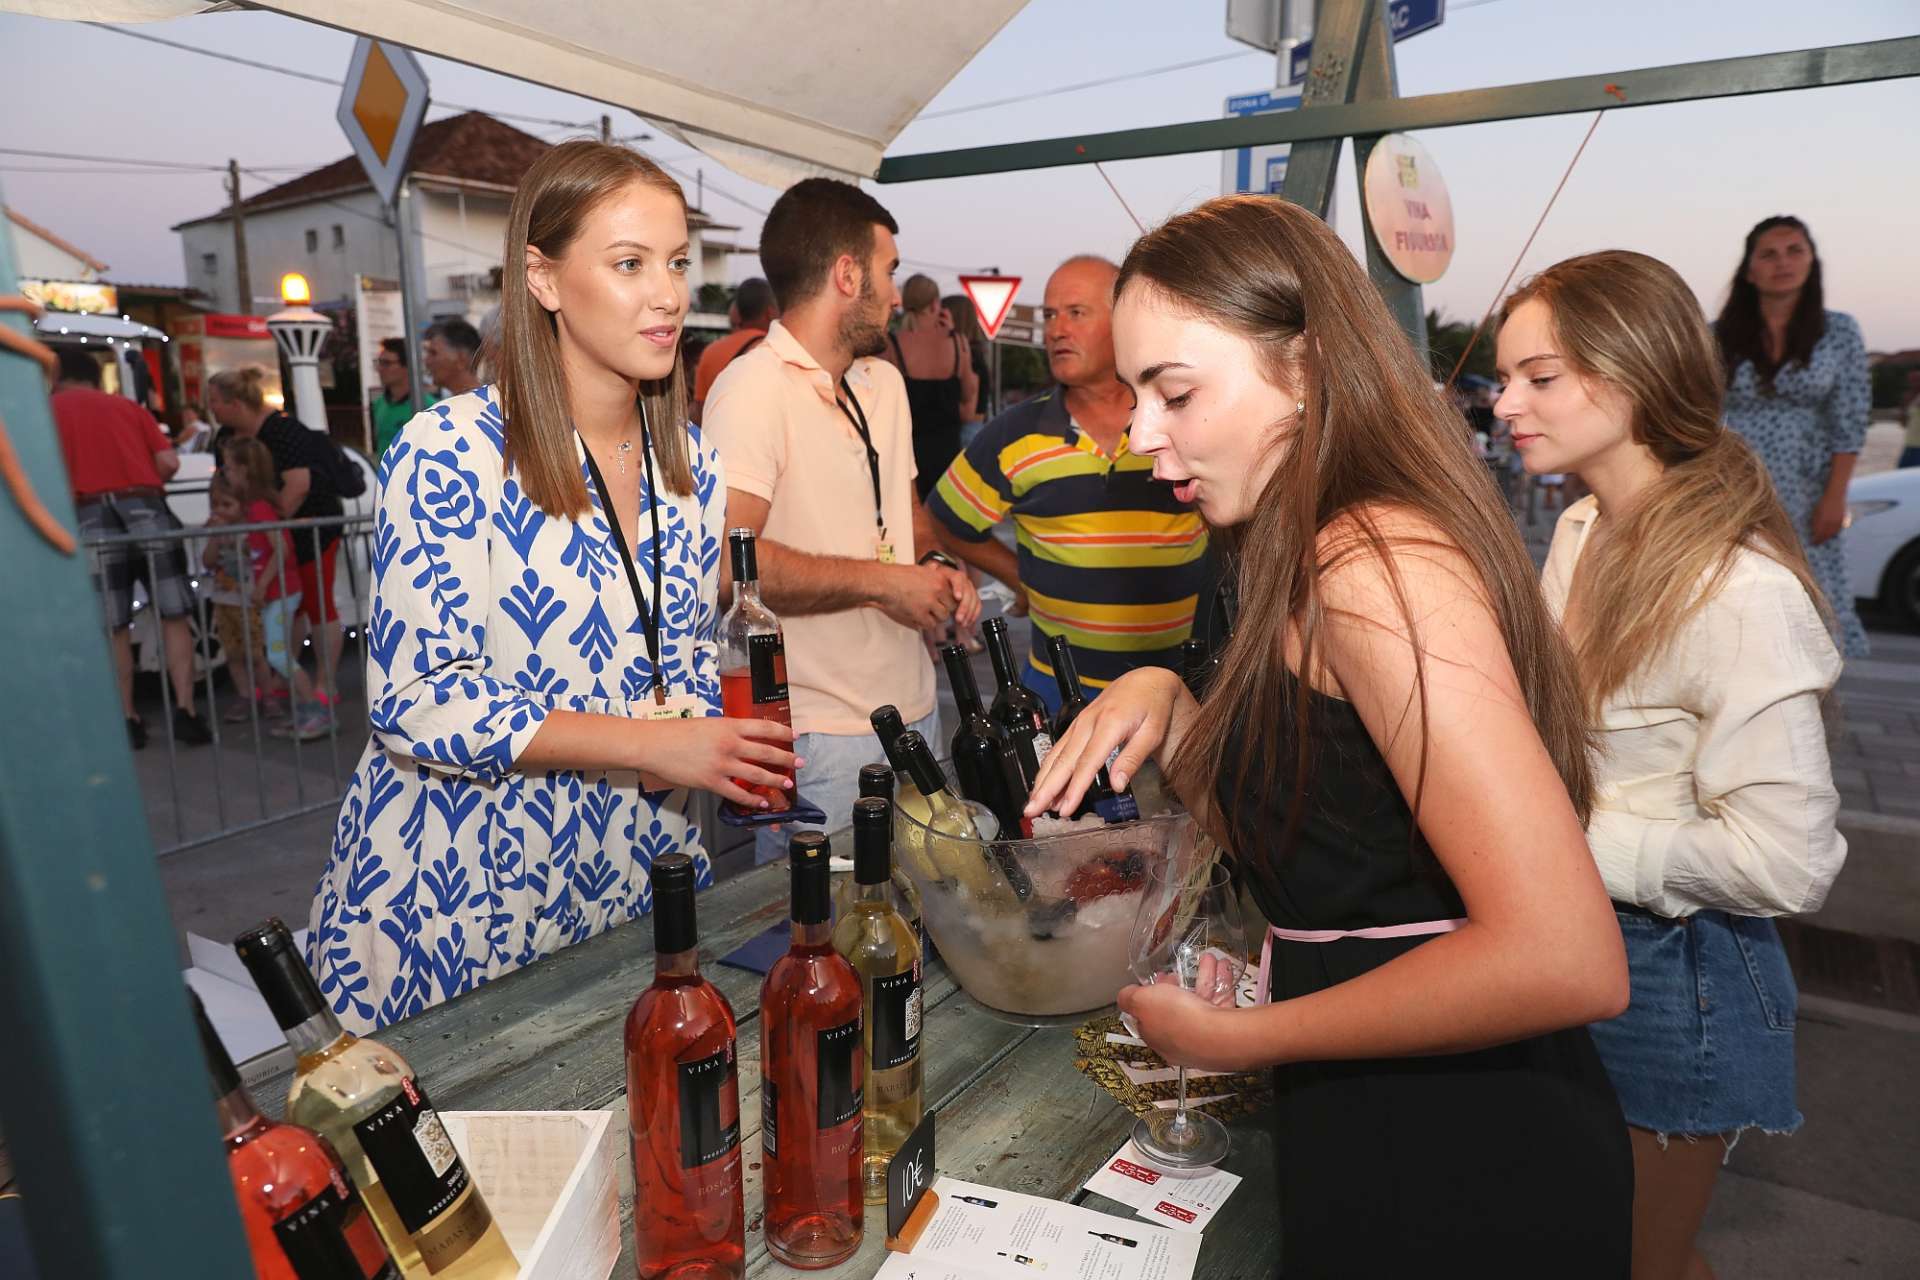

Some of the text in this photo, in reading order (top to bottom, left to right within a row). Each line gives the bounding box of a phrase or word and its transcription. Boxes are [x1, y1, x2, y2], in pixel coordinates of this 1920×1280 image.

[881, 979, 907, 989] VINA
[826, 1027, 854, 1041] VINA
[688, 1059, 719, 1075] VINA
[366, 1105, 403, 1131] VINA
[902, 1148, 924, 1208] 10€
[428, 1187, 457, 1216] PRODUCT
[287, 1199, 329, 1231] VINA
